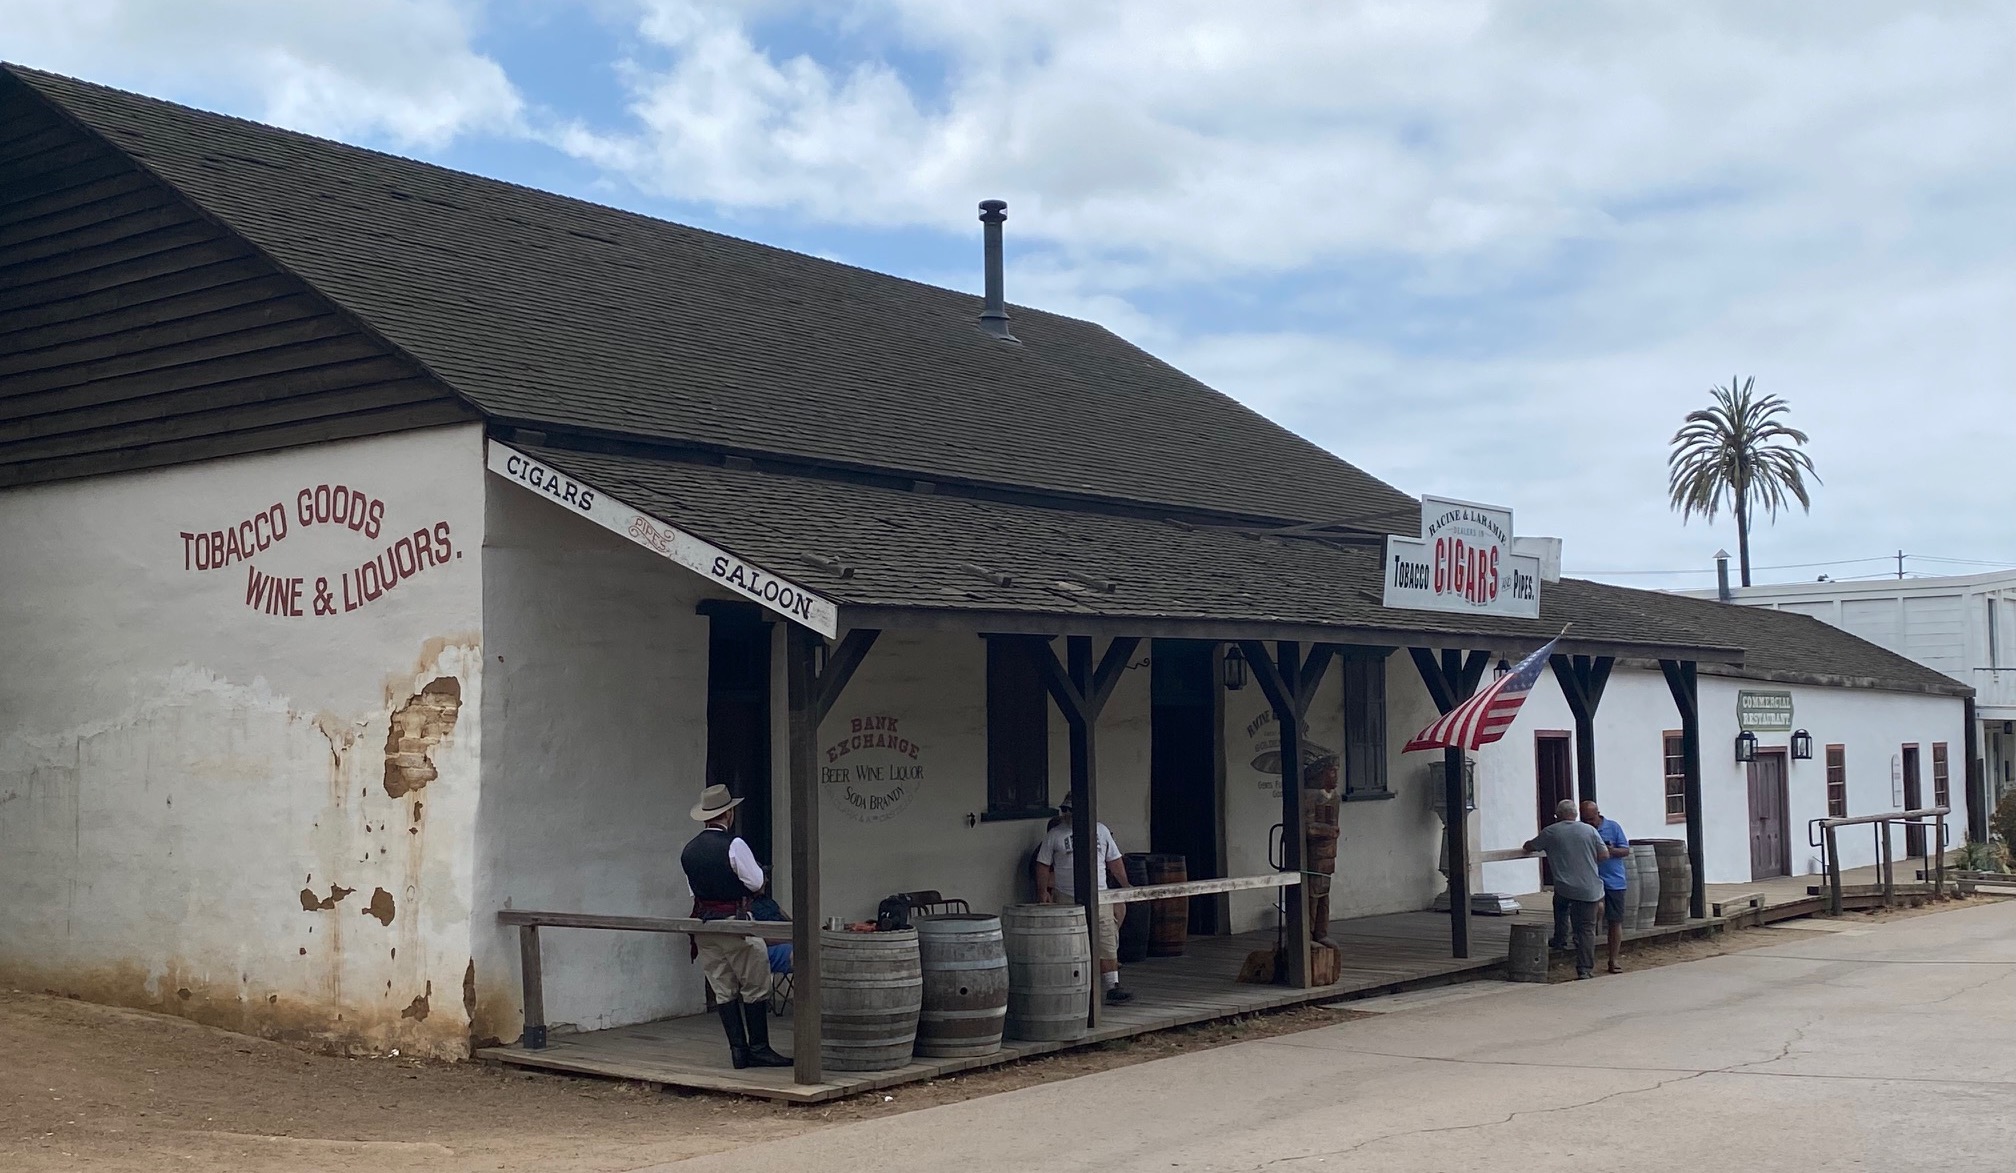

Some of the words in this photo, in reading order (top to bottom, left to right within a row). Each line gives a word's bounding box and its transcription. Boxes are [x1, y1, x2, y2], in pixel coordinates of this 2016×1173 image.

[180, 502, 287, 571] TOBACCO
[298, 484, 385, 540] GOODS
[1428, 509, 1461, 537] RACINE
[1462, 509, 1468, 520] &
[507, 455, 595, 511] CIGARS
[635, 518, 667, 550] PIPES
[711, 556, 813, 620] SALOON
[246, 566, 304, 616] WINE
[312, 577, 337, 616] &
[343, 521, 463, 613] LIQUORS.
[1394, 555, 1430, 590] TOBACCO
[1434, 537, 1500, 606] CIGARS
[1742, 696, 1791, 708] COMMERCIAL
[851, 716, 898, 733] BANK
[1742, 712, 1791, 725] RESTAURANT
[826, 734, 920, 763] EXCHANGE
[822, 766, 850, 783] BEER
[856, 765, 884, 782] WINE
[890, 764, 924, 781] LIQUOR
[845, 786, 866, 809] SODA
[870, 784, 905, 810] BRANDY
